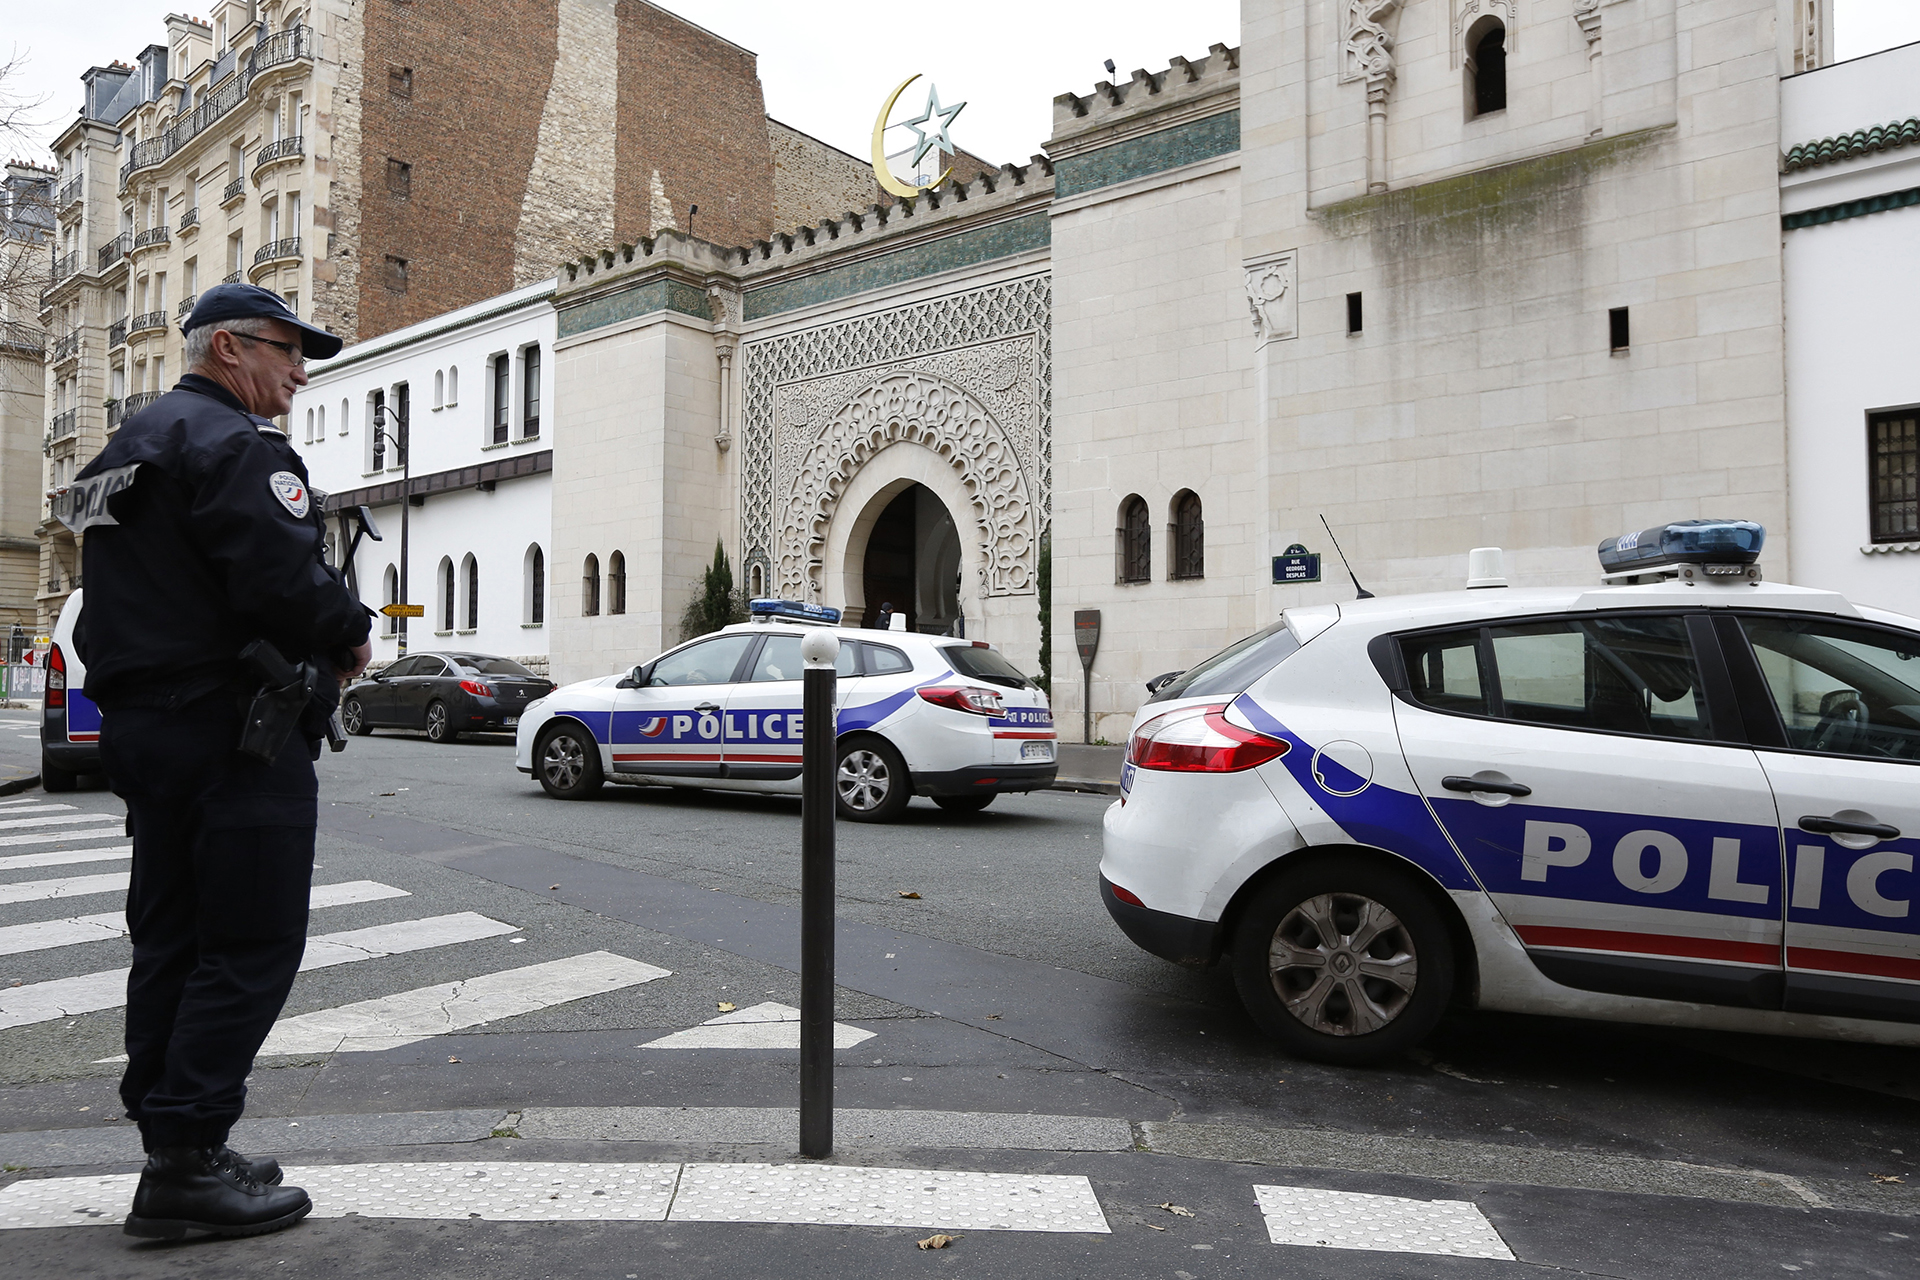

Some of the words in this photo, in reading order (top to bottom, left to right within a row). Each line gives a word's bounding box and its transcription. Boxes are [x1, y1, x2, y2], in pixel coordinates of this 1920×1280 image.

[672, 713, 804, 740] POLICE
[1020, 712, 1049, 723] POLICE
[1520, 819, 1914, 918] POLIC
